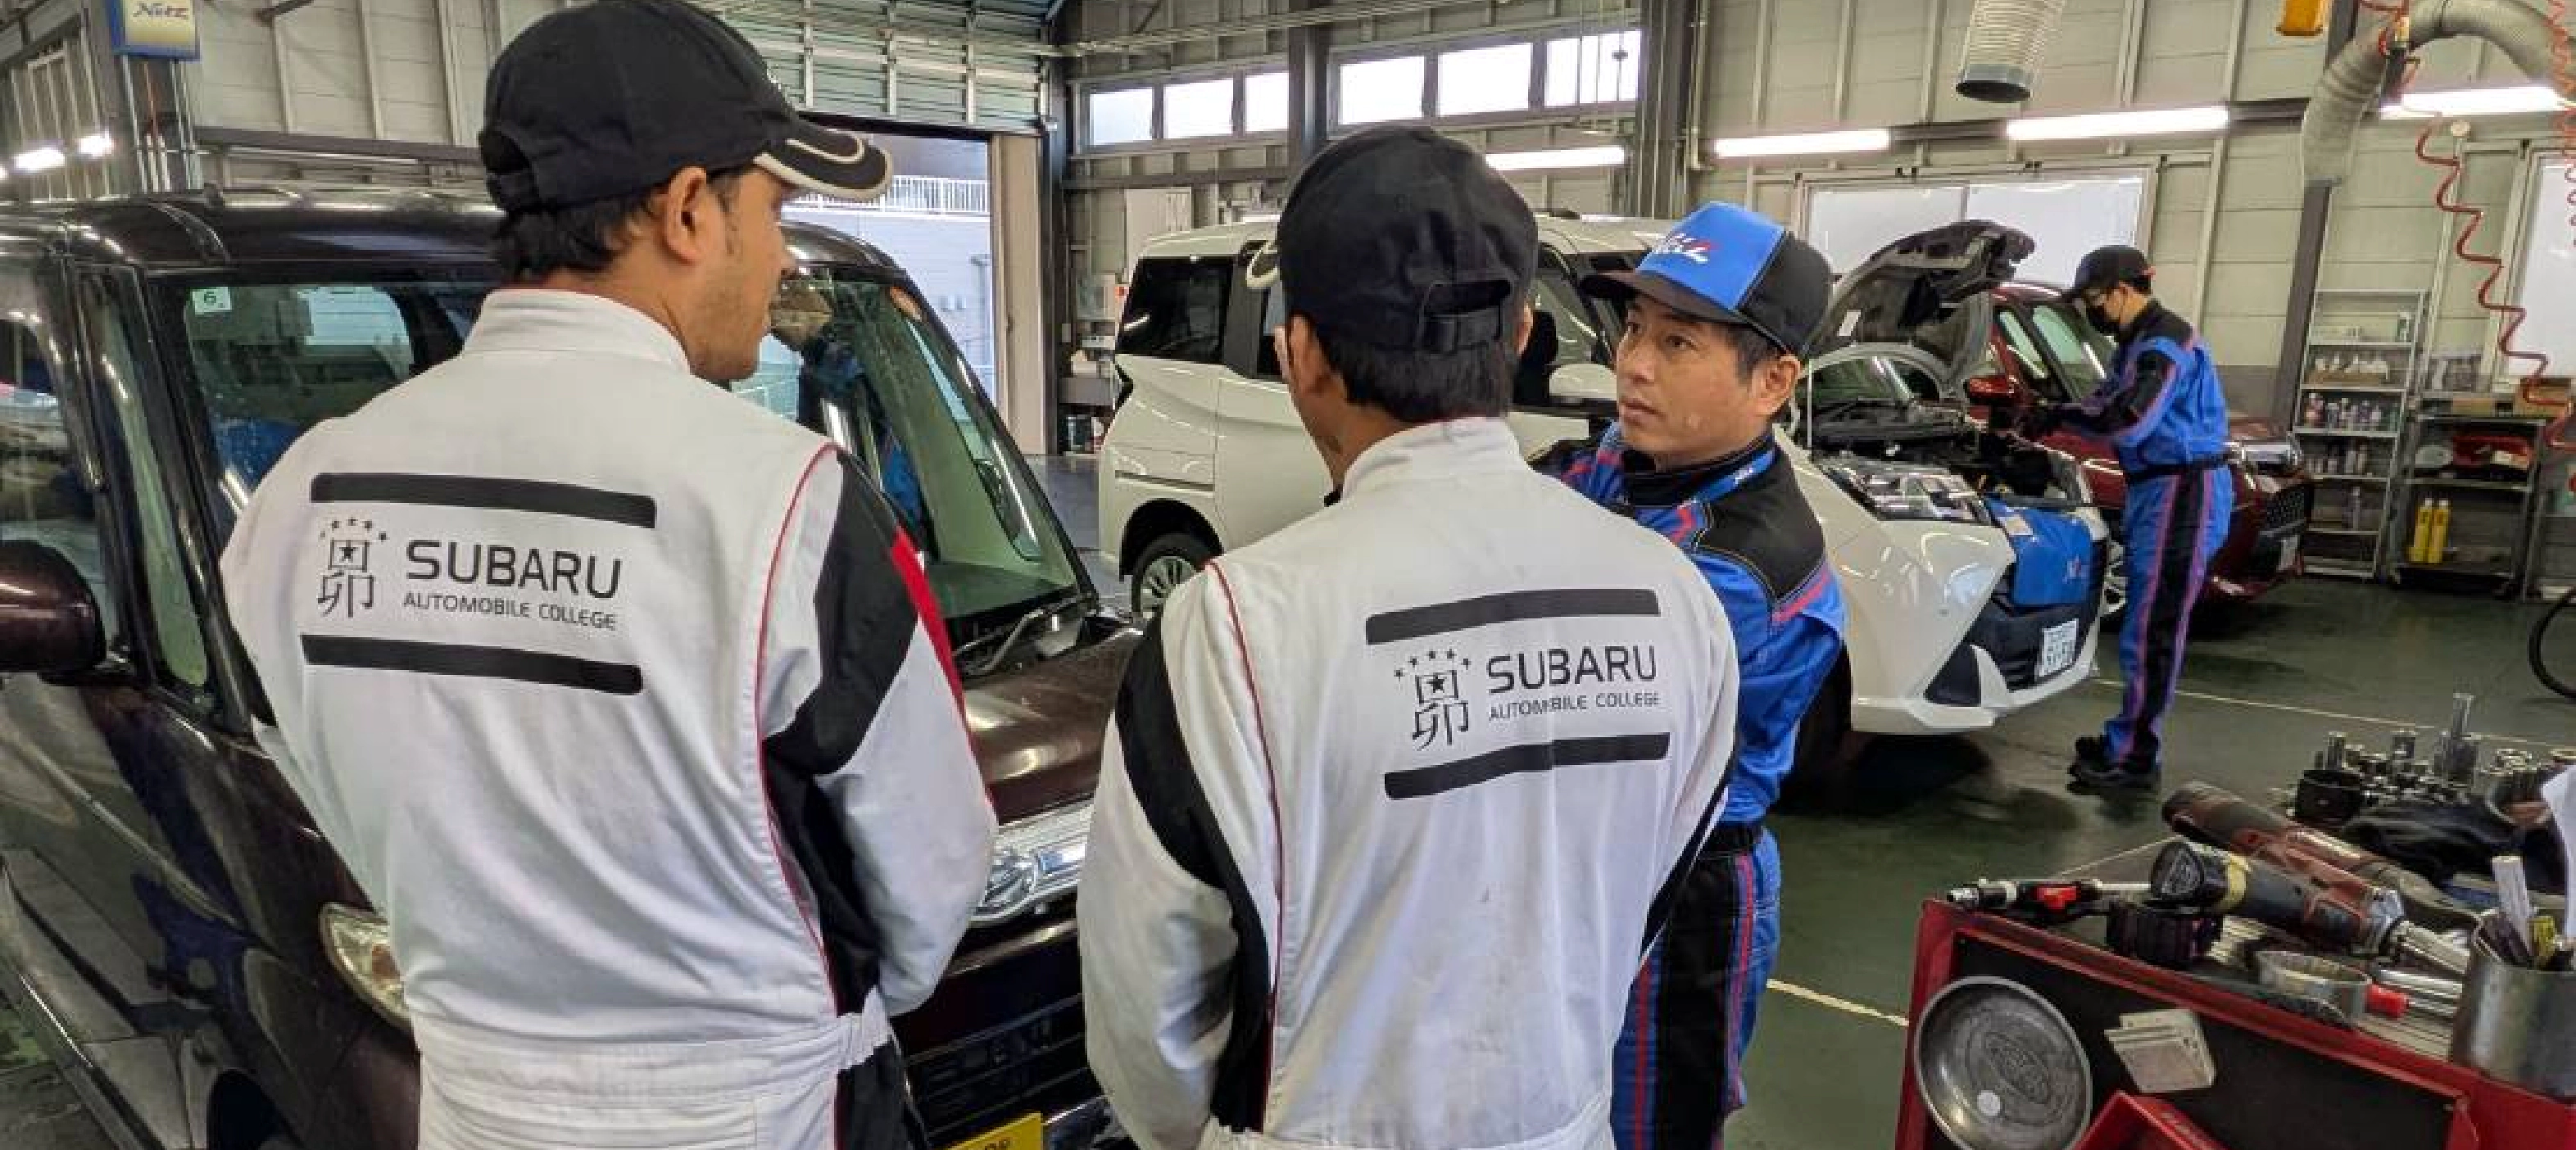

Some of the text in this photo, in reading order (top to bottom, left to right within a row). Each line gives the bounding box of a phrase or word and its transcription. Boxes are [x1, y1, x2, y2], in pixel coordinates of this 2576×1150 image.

[406, 539, 621, 600] SUBARU
[402, 591, 617, 630] AUTOMOBILE COLLEGE
[1486, 645, 1657, 695] SUBARU
[1595, 691, 1660, 708] COLLEGE
